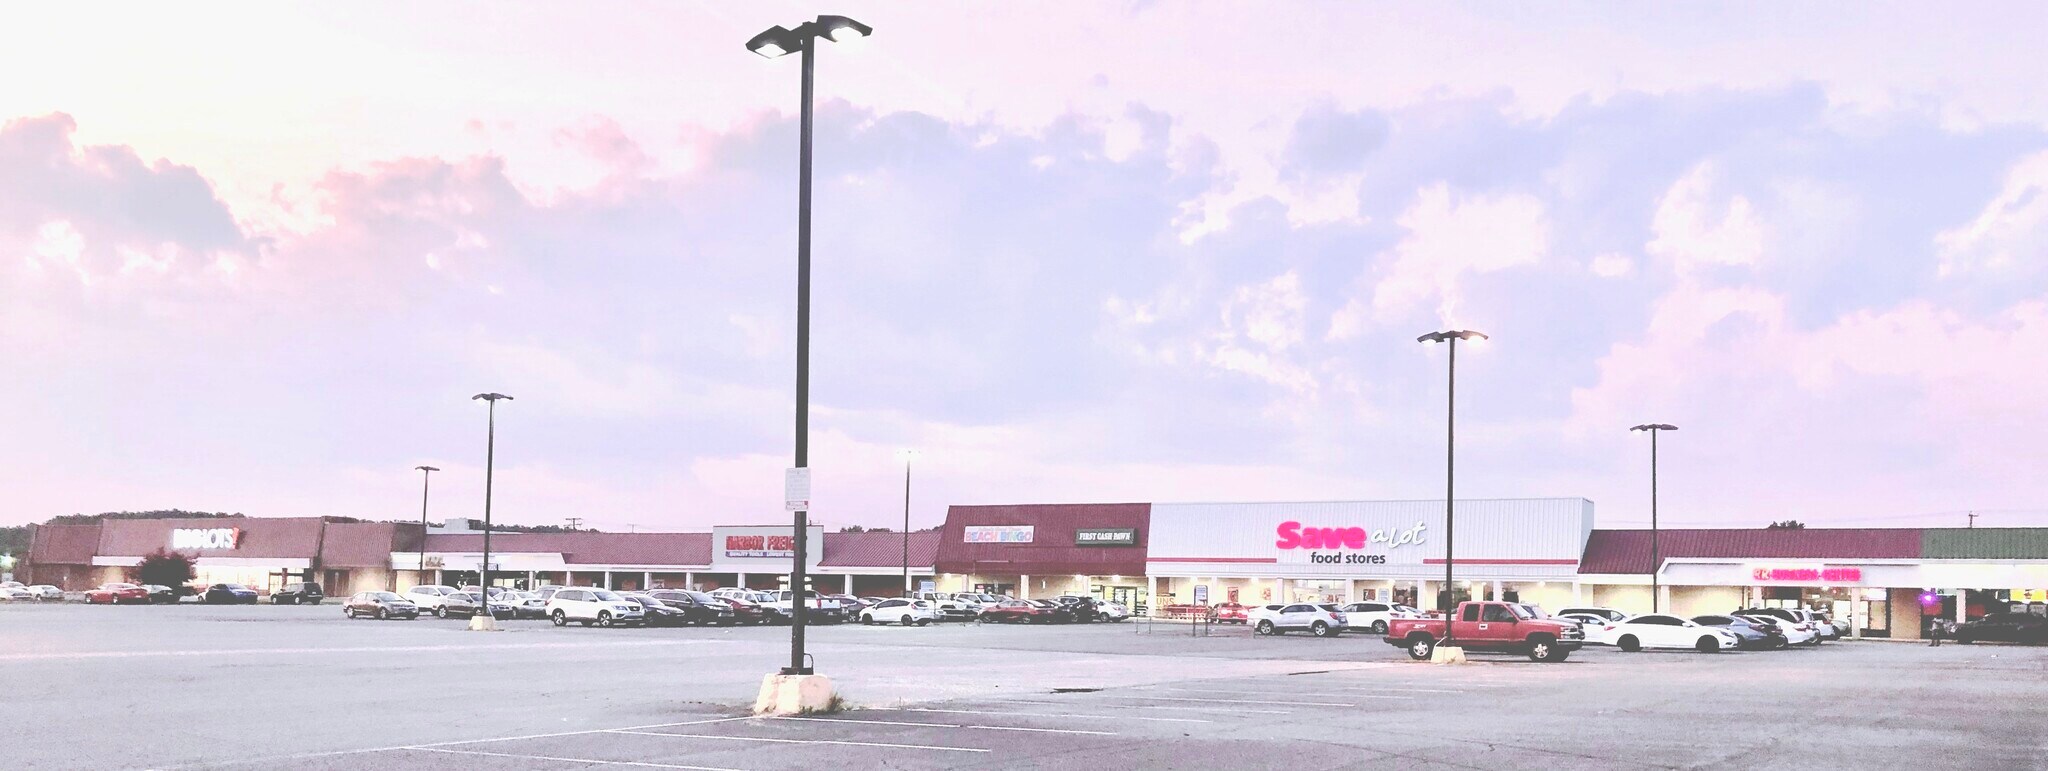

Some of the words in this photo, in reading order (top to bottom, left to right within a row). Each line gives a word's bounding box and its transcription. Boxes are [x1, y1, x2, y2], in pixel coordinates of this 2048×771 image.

[965, 531, 998, 541] BEACH
[1000, 531, 1032, 541] BINGO
[1079, 532, 1097, 541] FIRST
[1097, 532, 1113, 541] CASH
[1113, 532, 1131, 541] PAWN
[1276, 521, 1367, 549] Save
[726, 535, 764, 550] HARBOR
[1311, 552, 1342, 564] food
[1345, 552, 1386, 564] stores
